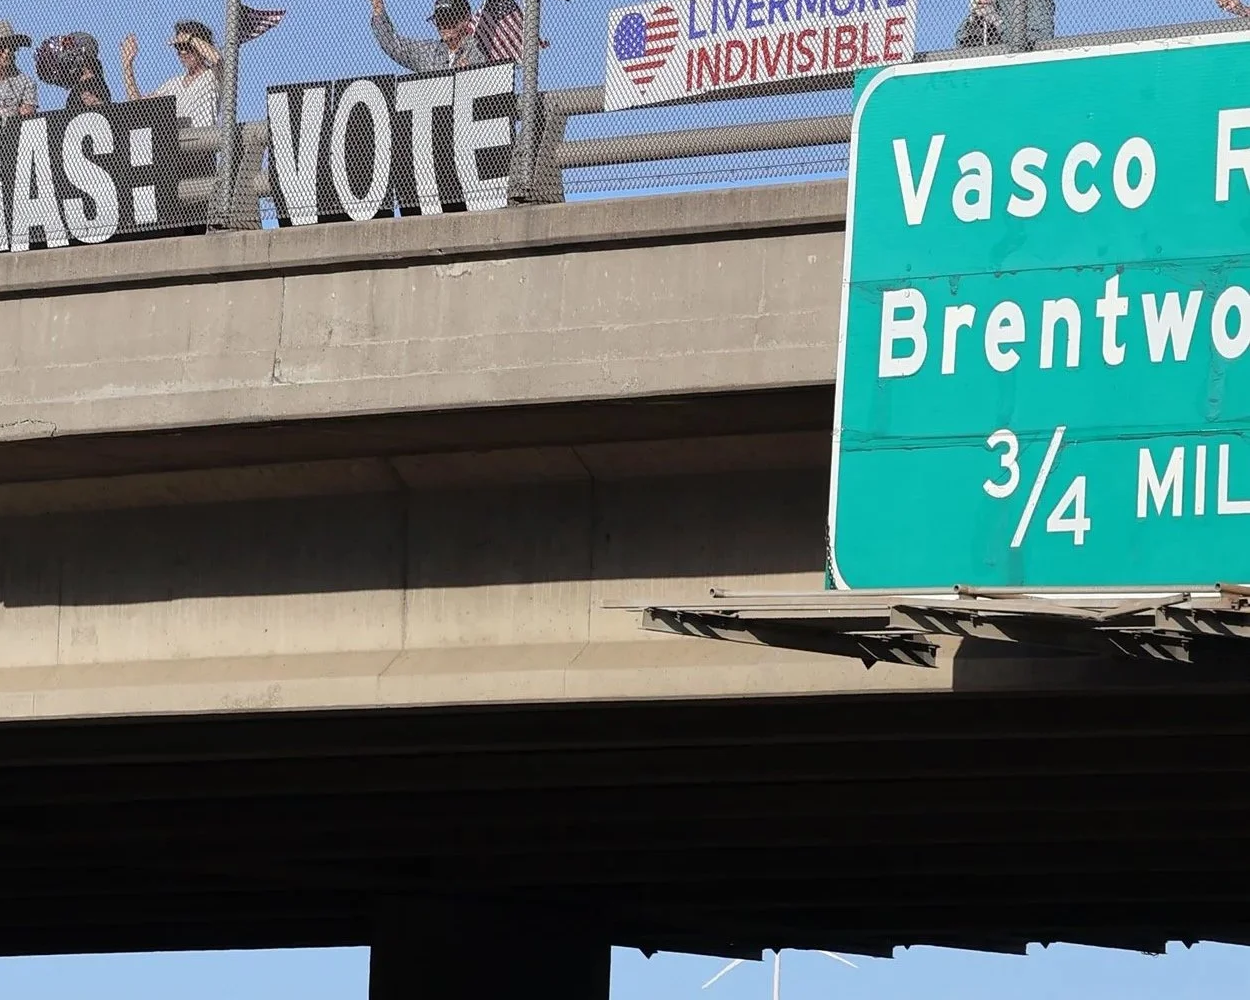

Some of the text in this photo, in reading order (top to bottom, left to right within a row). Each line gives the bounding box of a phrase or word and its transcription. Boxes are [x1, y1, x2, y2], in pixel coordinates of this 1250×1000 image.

[685, 16, 907, 92] INDIVISIBLE
[266, 62, 516, 227] VOTE
[892, 133, 1157, 226] Vasco
[878, 274, 1250, 379] Brentwo
[982, 425, 1250, 548] 3/4 MIL
